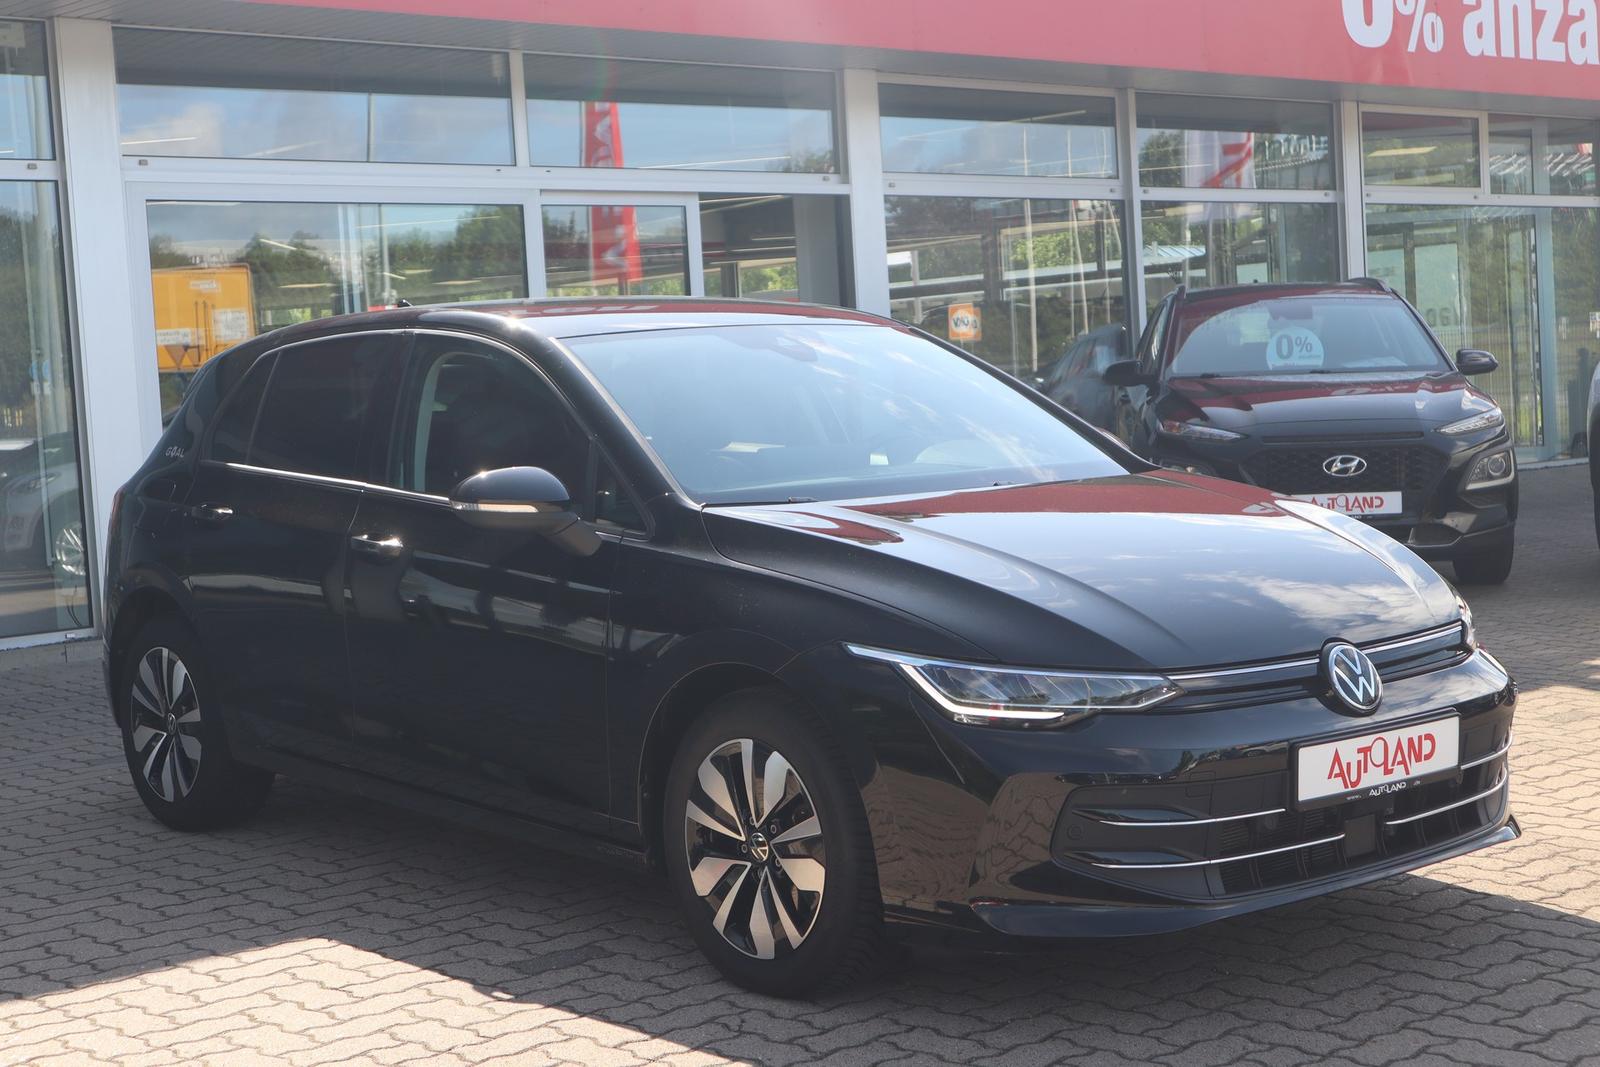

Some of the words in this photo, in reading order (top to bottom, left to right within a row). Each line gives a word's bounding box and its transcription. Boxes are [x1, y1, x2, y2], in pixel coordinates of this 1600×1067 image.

[1275, 334, 1313, 360] 0%
[1327, 732, 1437, 790] AUTOLAND
[1369, 781, 1407, 797] AUTOLAND
